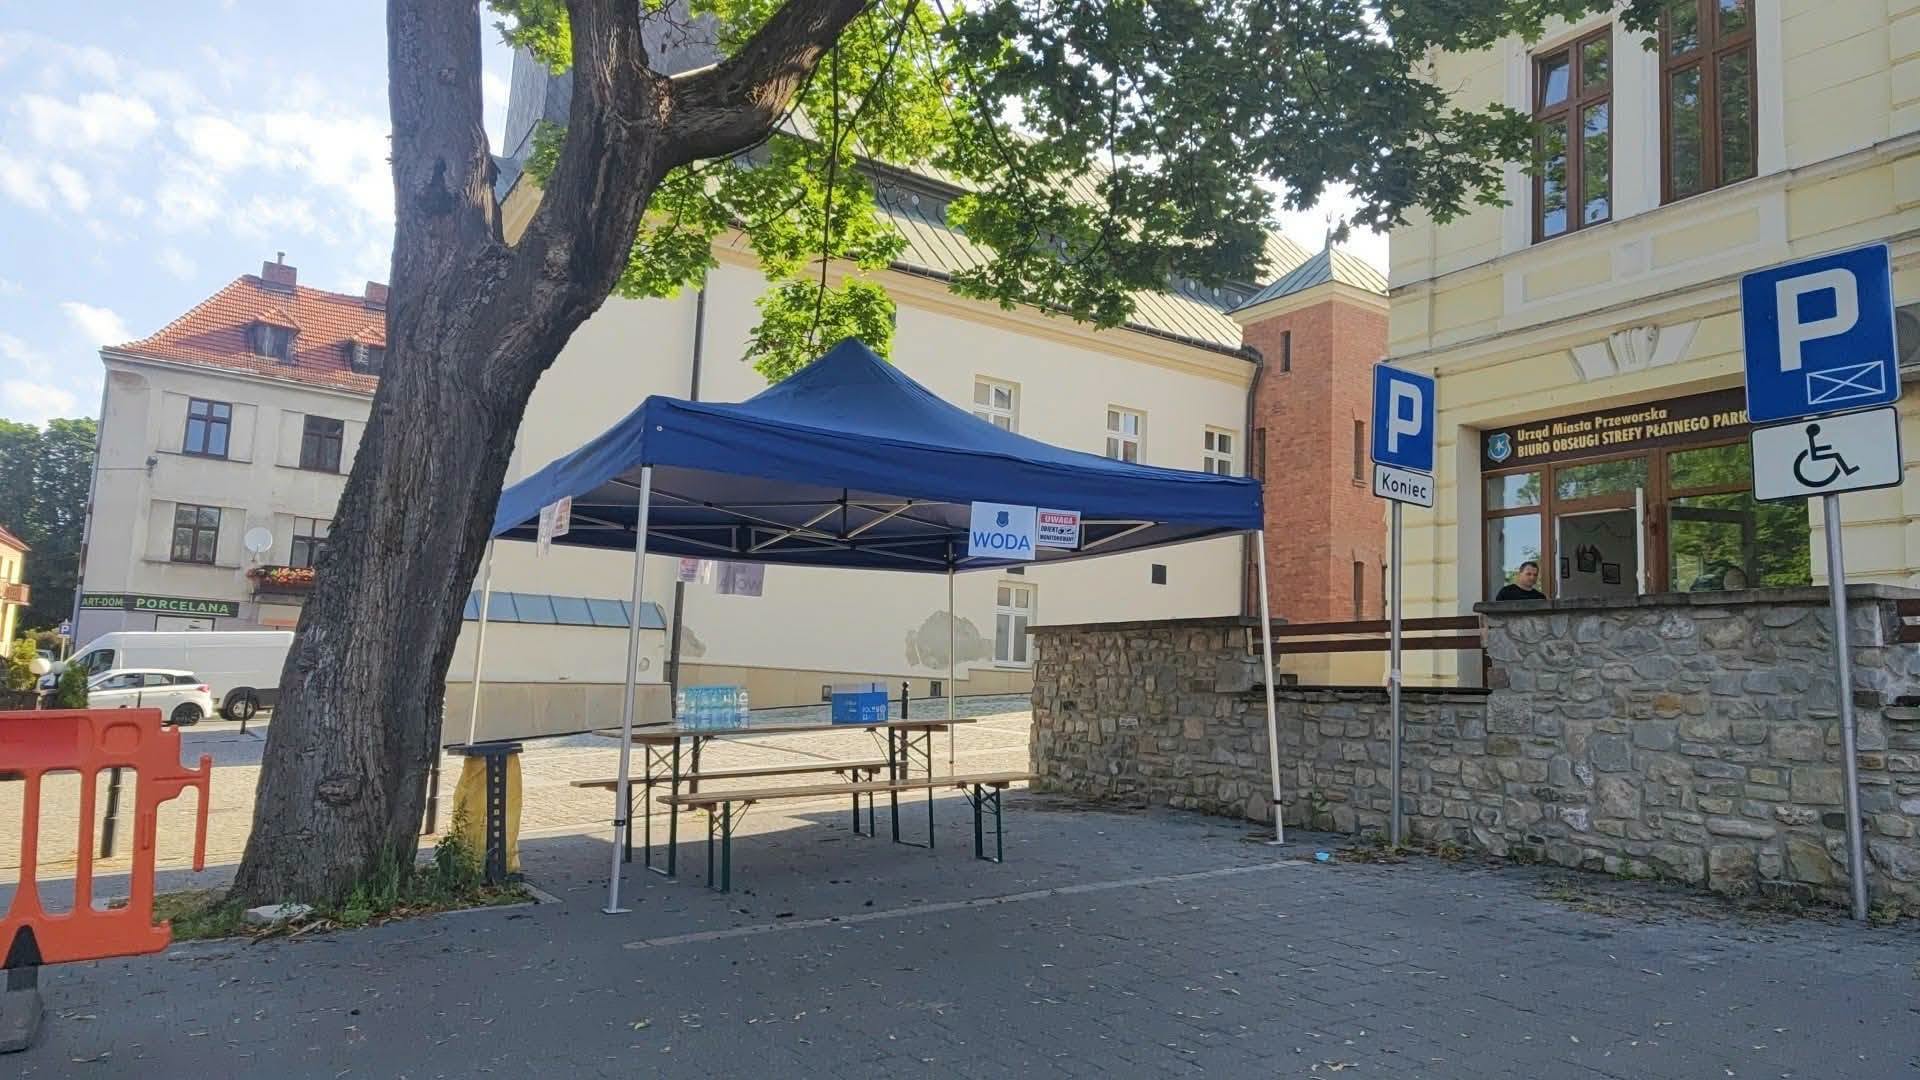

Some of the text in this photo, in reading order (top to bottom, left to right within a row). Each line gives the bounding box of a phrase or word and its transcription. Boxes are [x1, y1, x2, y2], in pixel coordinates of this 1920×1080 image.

[1776, 268, 1859, 373] P
[1388, 378, 1423, 454] P
[1517, 407, 1668, 442] Urząd Miasta Przeworska
[1517, 441, 1551, 458] BIURO
[1552, 434, 1599, 453] OBSŁUGI
[1602, 426, 1643, 445] STREFY
[1646, 415, 1710, 439] PŁATNEGO
[1382, 471, 1427, 499] Koniec
[1045, 514, 1073, 524] UWAGA
[973, 531, 1031, 551] WODA
[82, 597, 229, 613] ART-DOM PORCELANA
